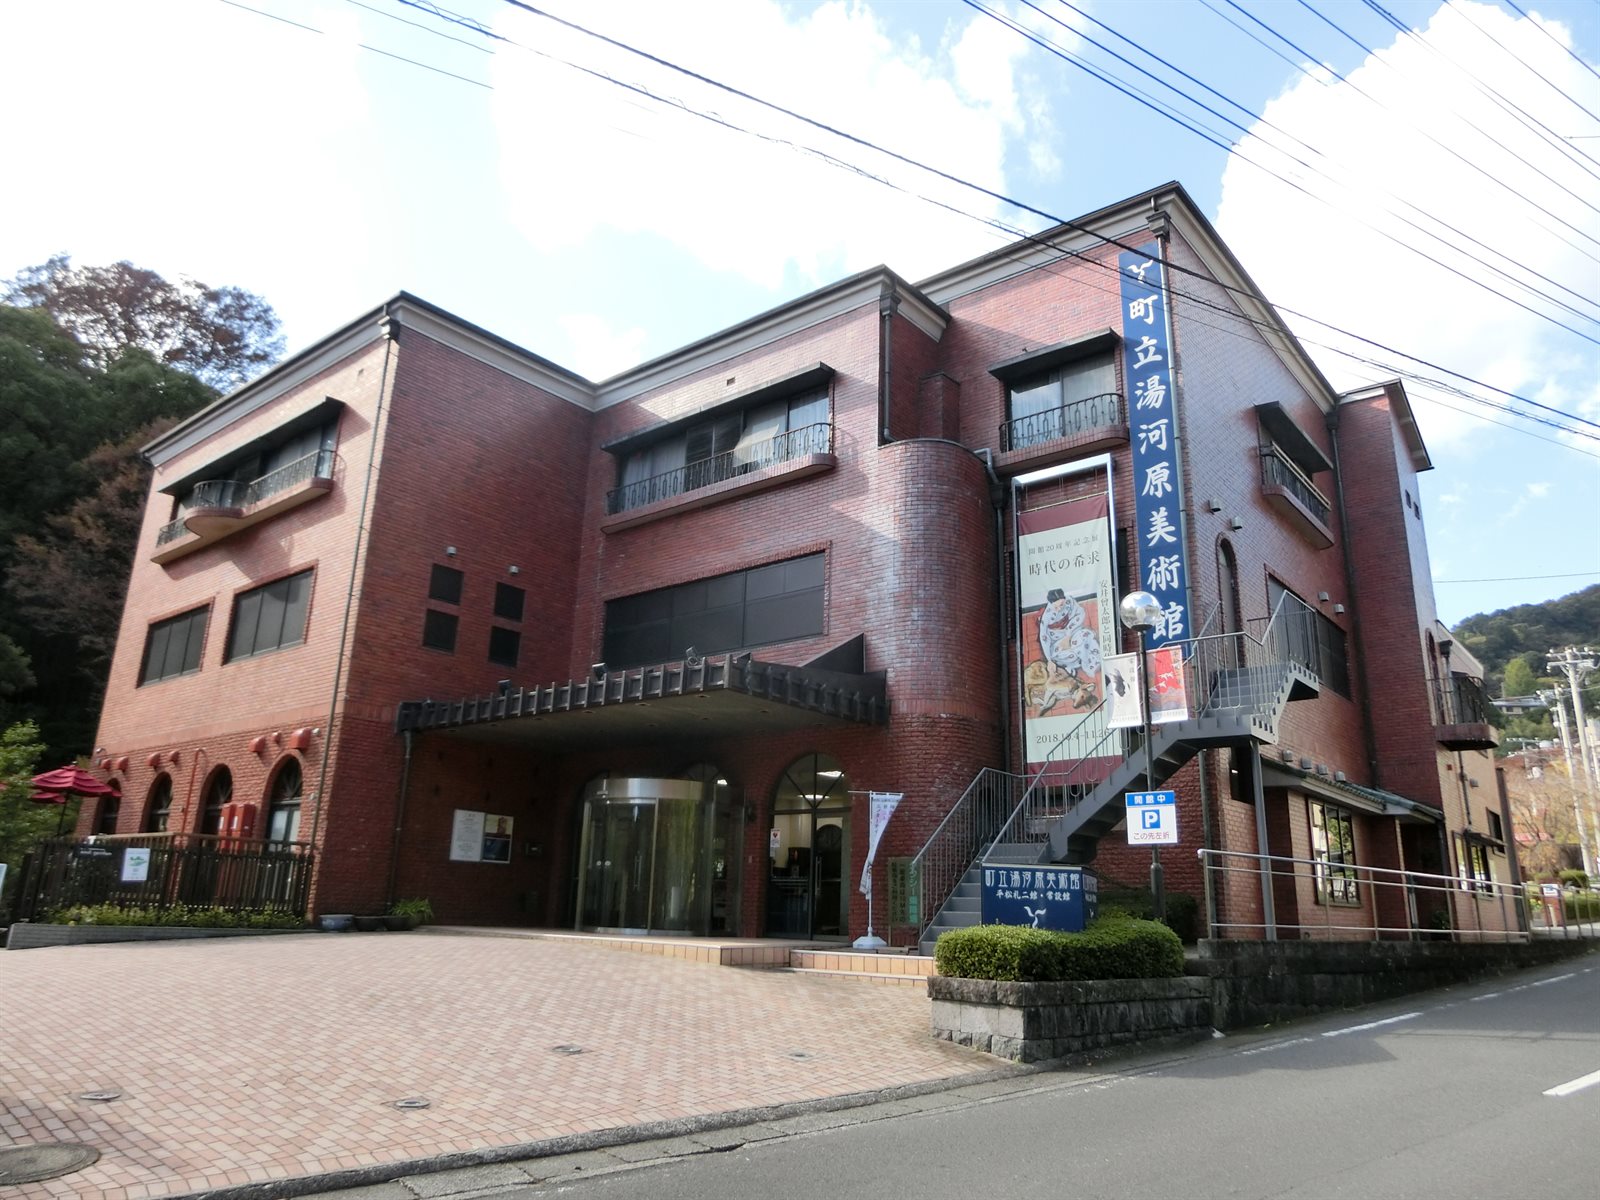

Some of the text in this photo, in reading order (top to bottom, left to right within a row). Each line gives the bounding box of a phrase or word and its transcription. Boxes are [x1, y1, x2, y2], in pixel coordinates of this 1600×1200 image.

[1129, 294, 1184, 641] 町立湯河原美術館
[1029, 550, 1100, 575] 時代の希求
[1144, 811, 1158, 828] P
[985, 869, 1080, 890] 町立湯河原美術館
